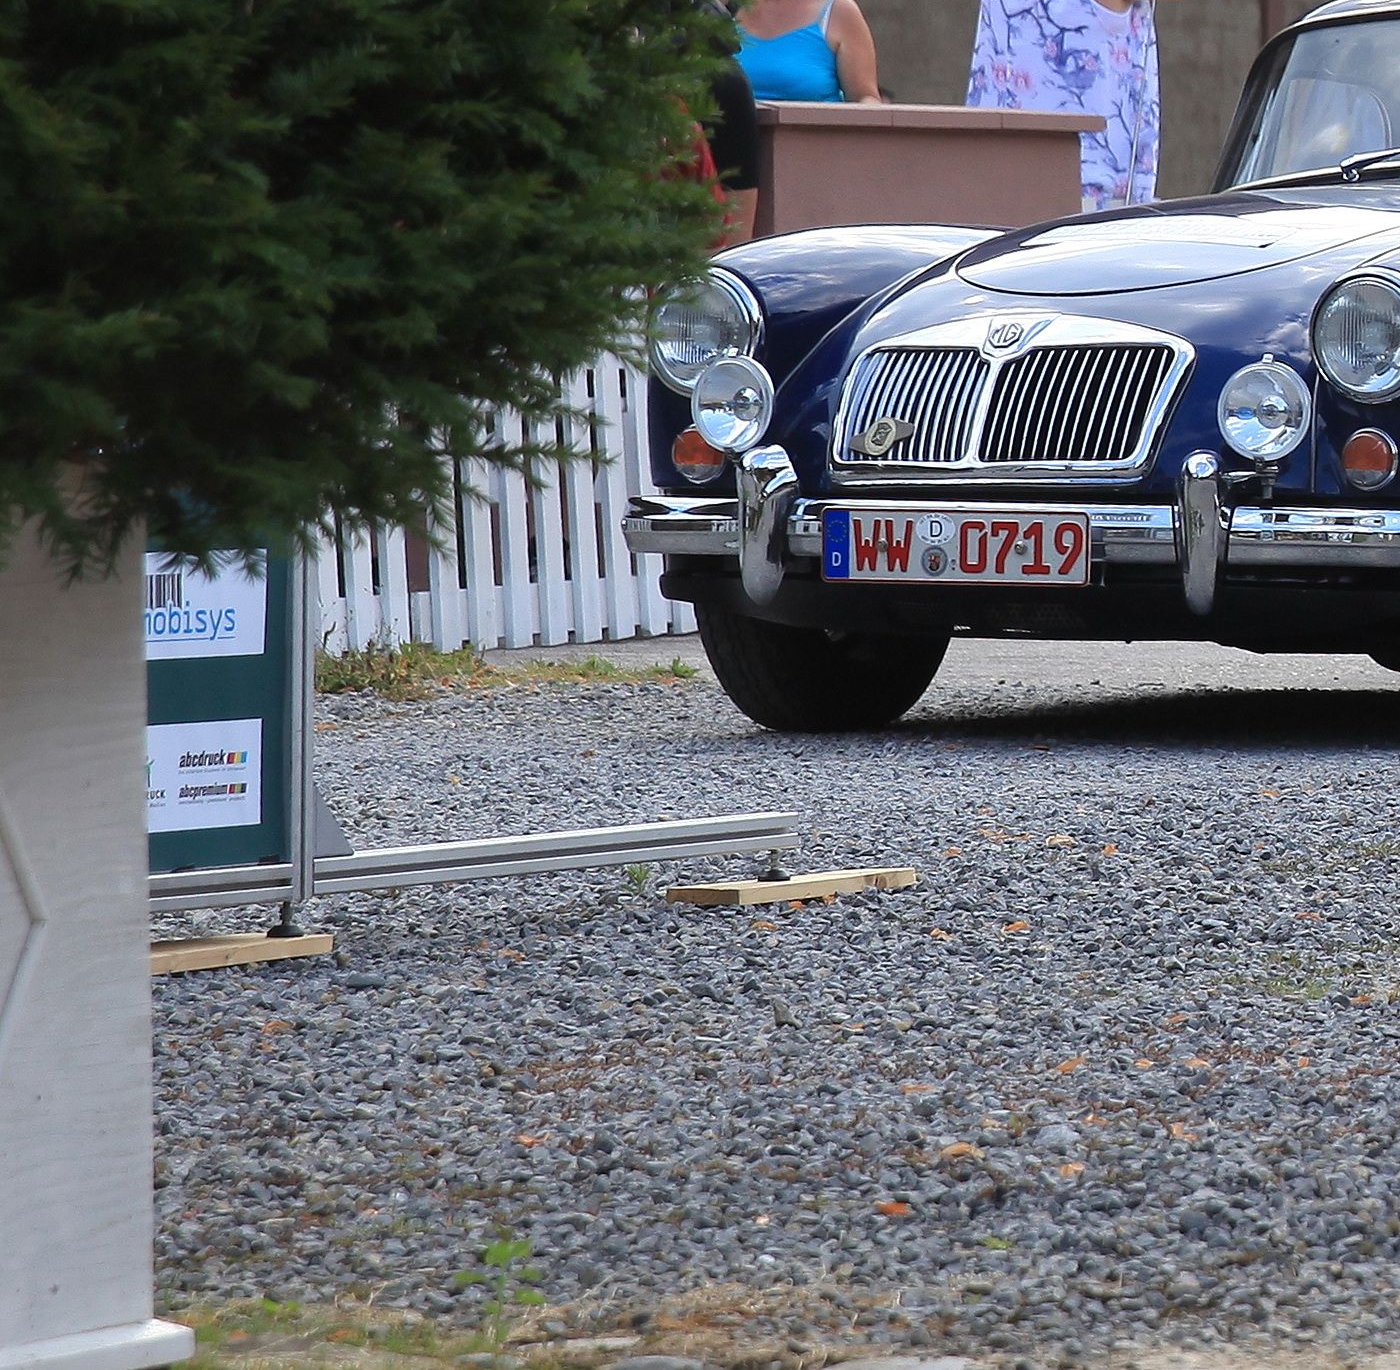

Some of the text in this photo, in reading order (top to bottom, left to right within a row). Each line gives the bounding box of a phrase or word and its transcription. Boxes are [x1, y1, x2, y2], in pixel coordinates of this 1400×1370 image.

[992, 324, 1018, 343] MG
[852, 519, 1084, 575] WW 0719
[831, 551, 842, 567] D
[178, 749, 227, 769] abcdruck
